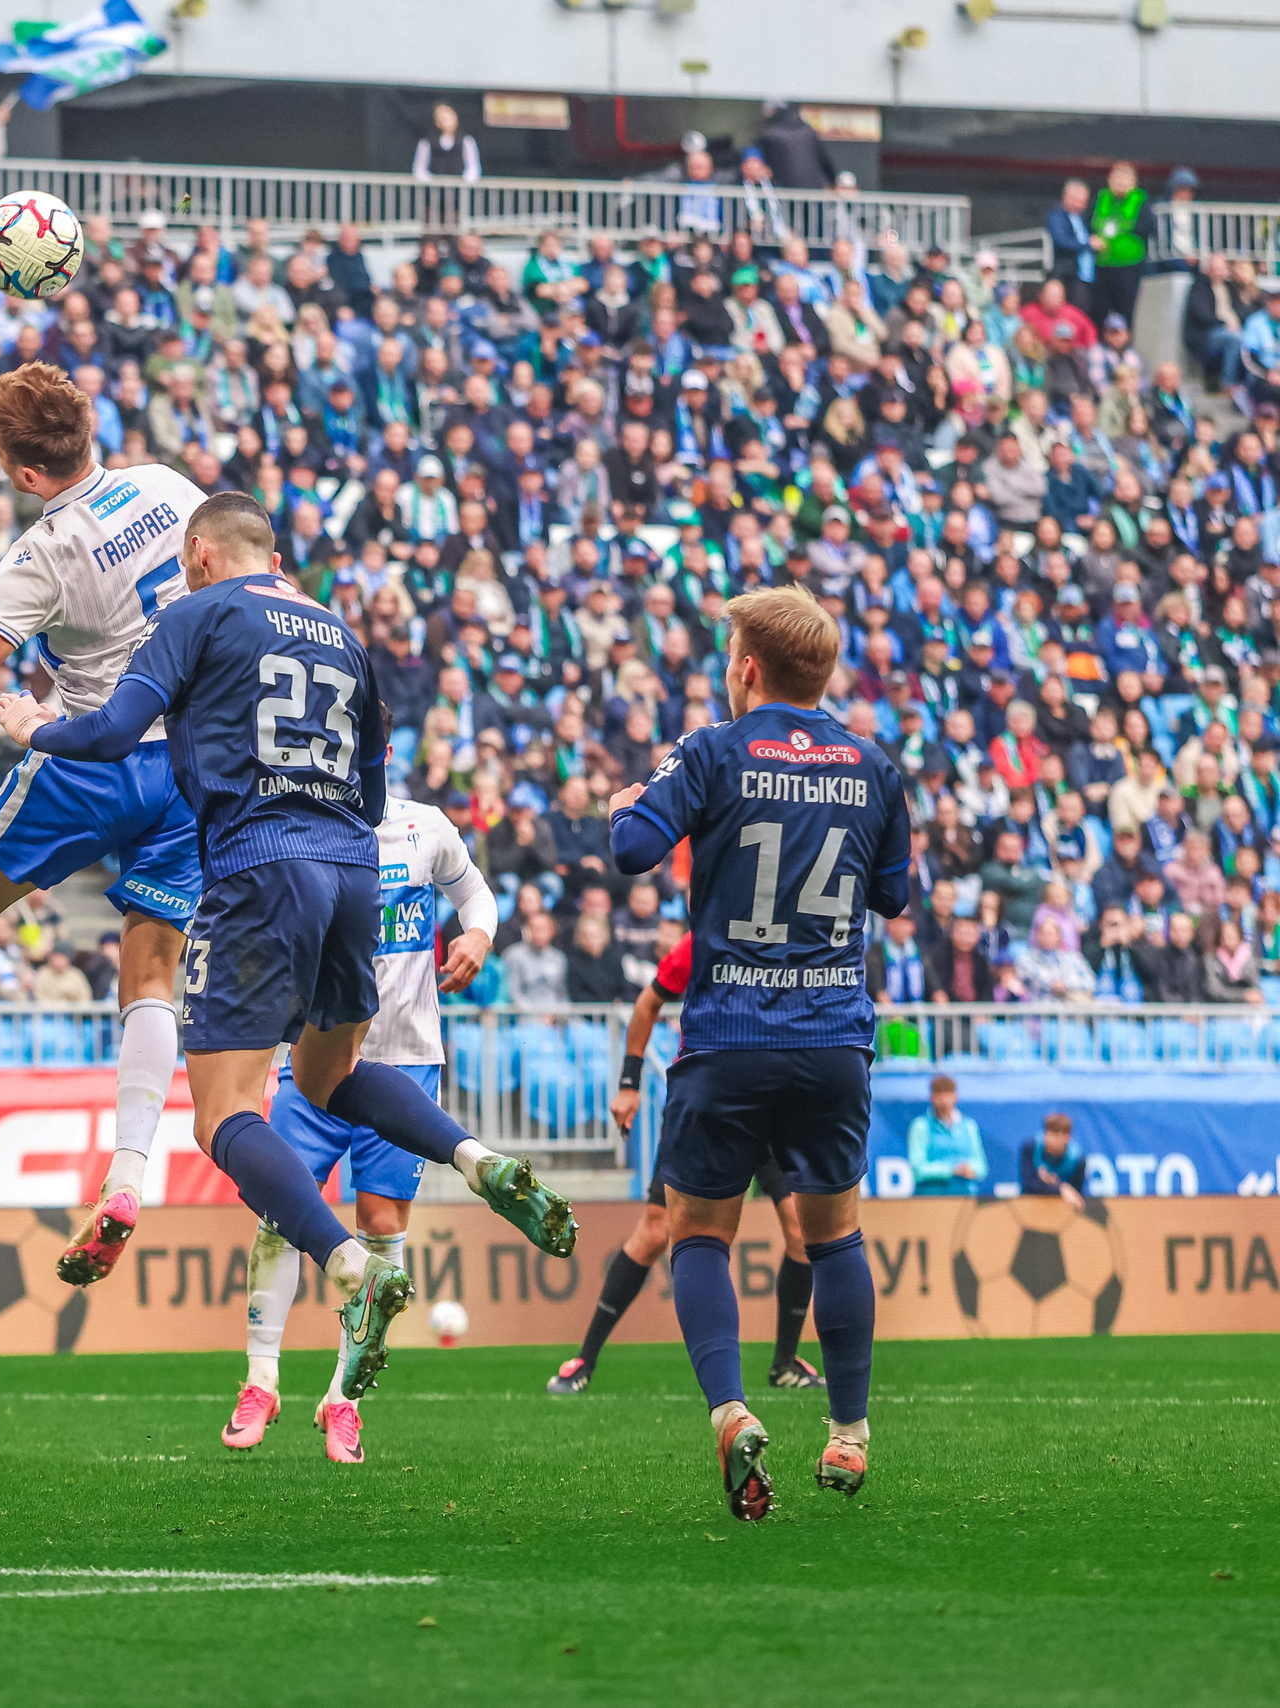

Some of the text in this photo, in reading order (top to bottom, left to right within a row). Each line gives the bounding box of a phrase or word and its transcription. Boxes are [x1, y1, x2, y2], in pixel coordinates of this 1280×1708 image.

[93, 484, 137, 517] БЕТСИТИ
[93, 503, 179, 573] ГАБАРАЕВ
[265, 609, 344, 650] ЧЕРНОВ
[257, 654, 357, 780] 23
[756, 747, 855, 763] СОЛИДАРНОСТЬ
[741, 771, 868, 807] САЛТЫКОВ
[124, 880, 191, 912] БЕТСИТИ
[728, 822, 856, 947] 14
[712, 964, 798, 988] САМАРСКАЯ
